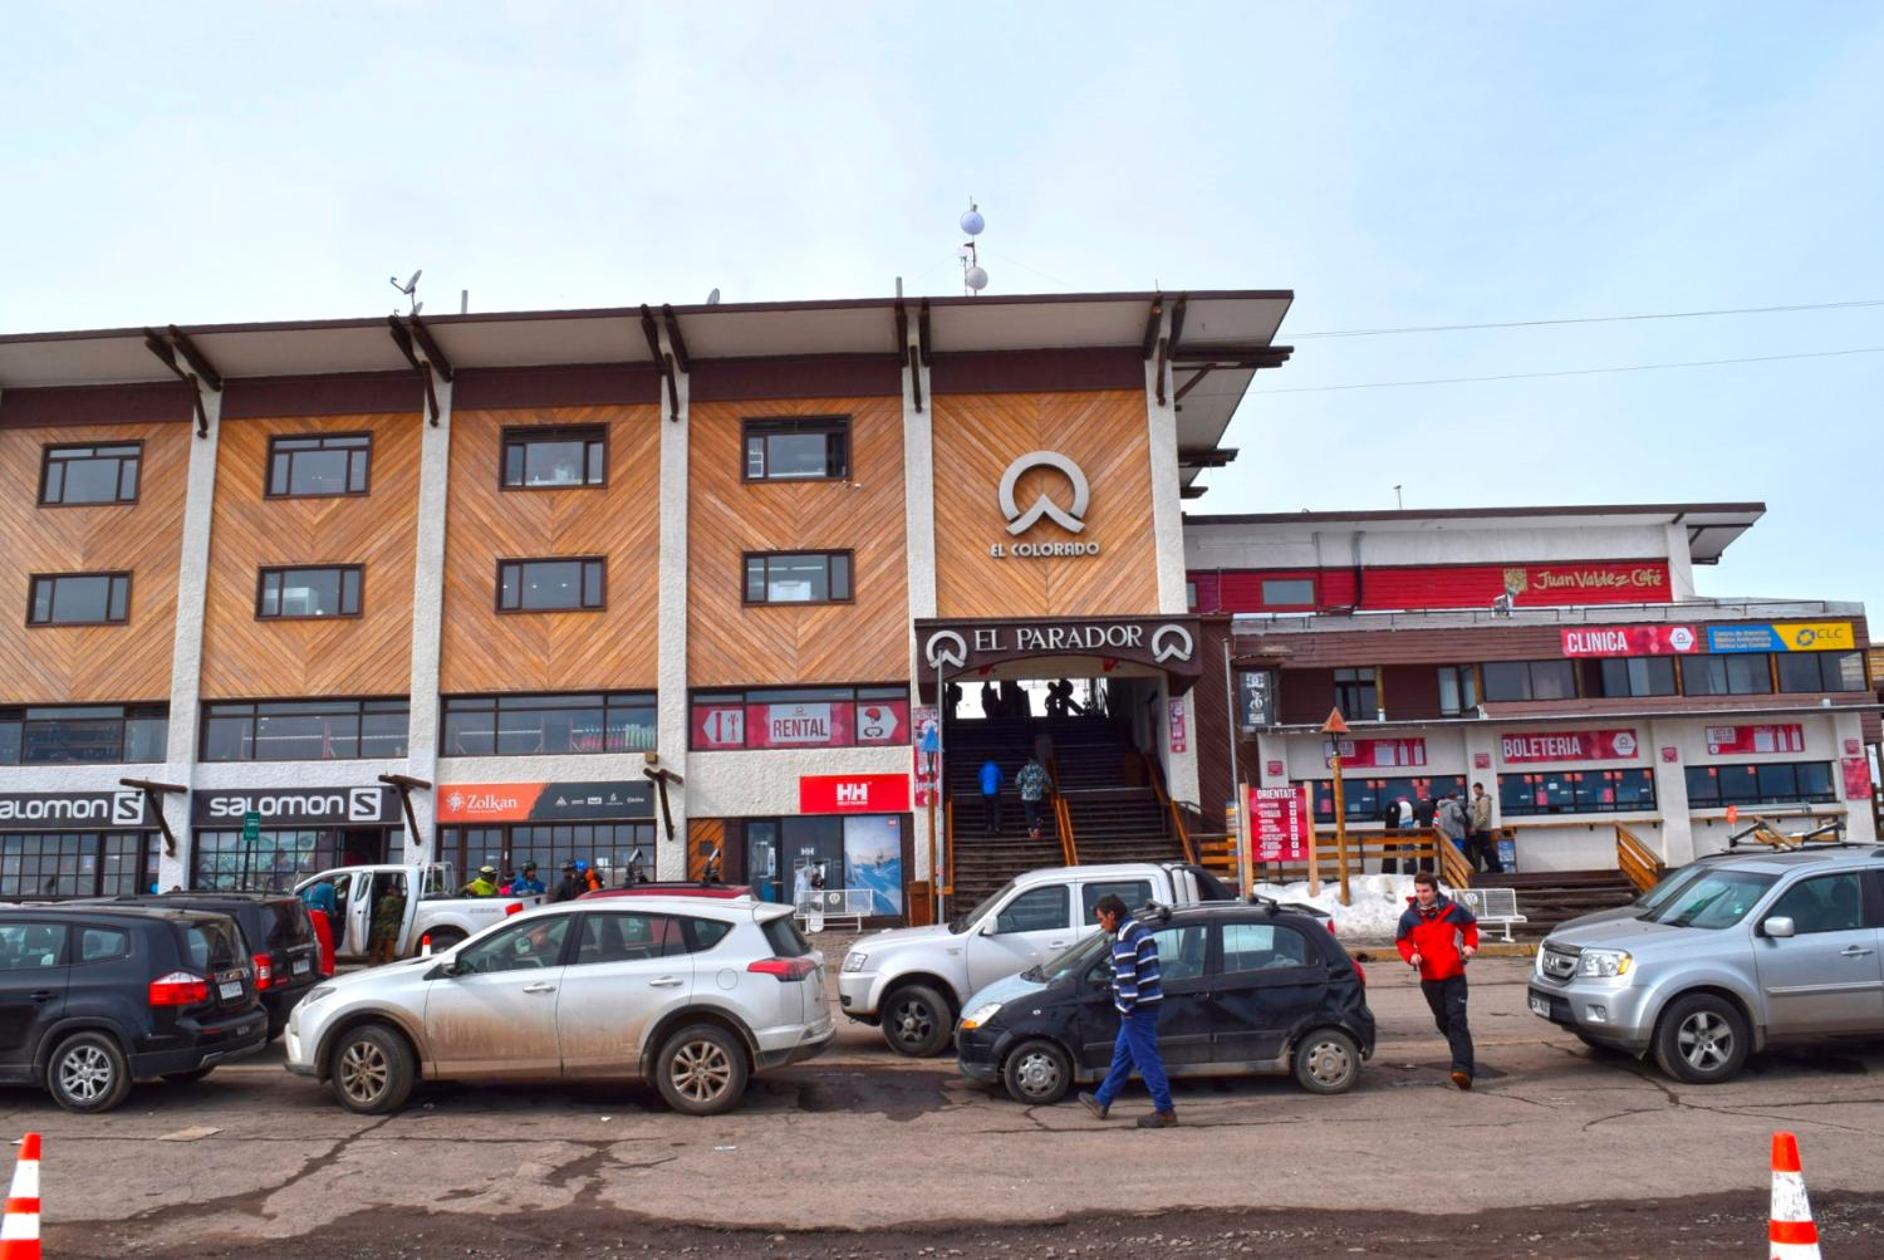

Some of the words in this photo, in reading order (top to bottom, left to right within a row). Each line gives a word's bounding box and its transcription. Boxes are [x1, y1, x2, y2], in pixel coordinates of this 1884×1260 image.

[990, 543, 1006, 558] EL
[1011, 541, 1100, 557] COLORADO
[1533, 570, 1574, 589] Juan
[1574, 570, 1630, 587] Valdez
[974, 628, 1007, 651] EL
[1016, 625, 1143, 650] PARADOR
[1567, 630, 1628, 653] CLINICA
[1816, 627, 1843, 639] CLC
[773, 718, 828, 737] RENTAL
[1503, 736, 1582, 757] BOLETERIA
[836, 783, 868, 801] HH
[0, 799, 108, 819] alomon
[467, 793, 518, 811] Zolkan
